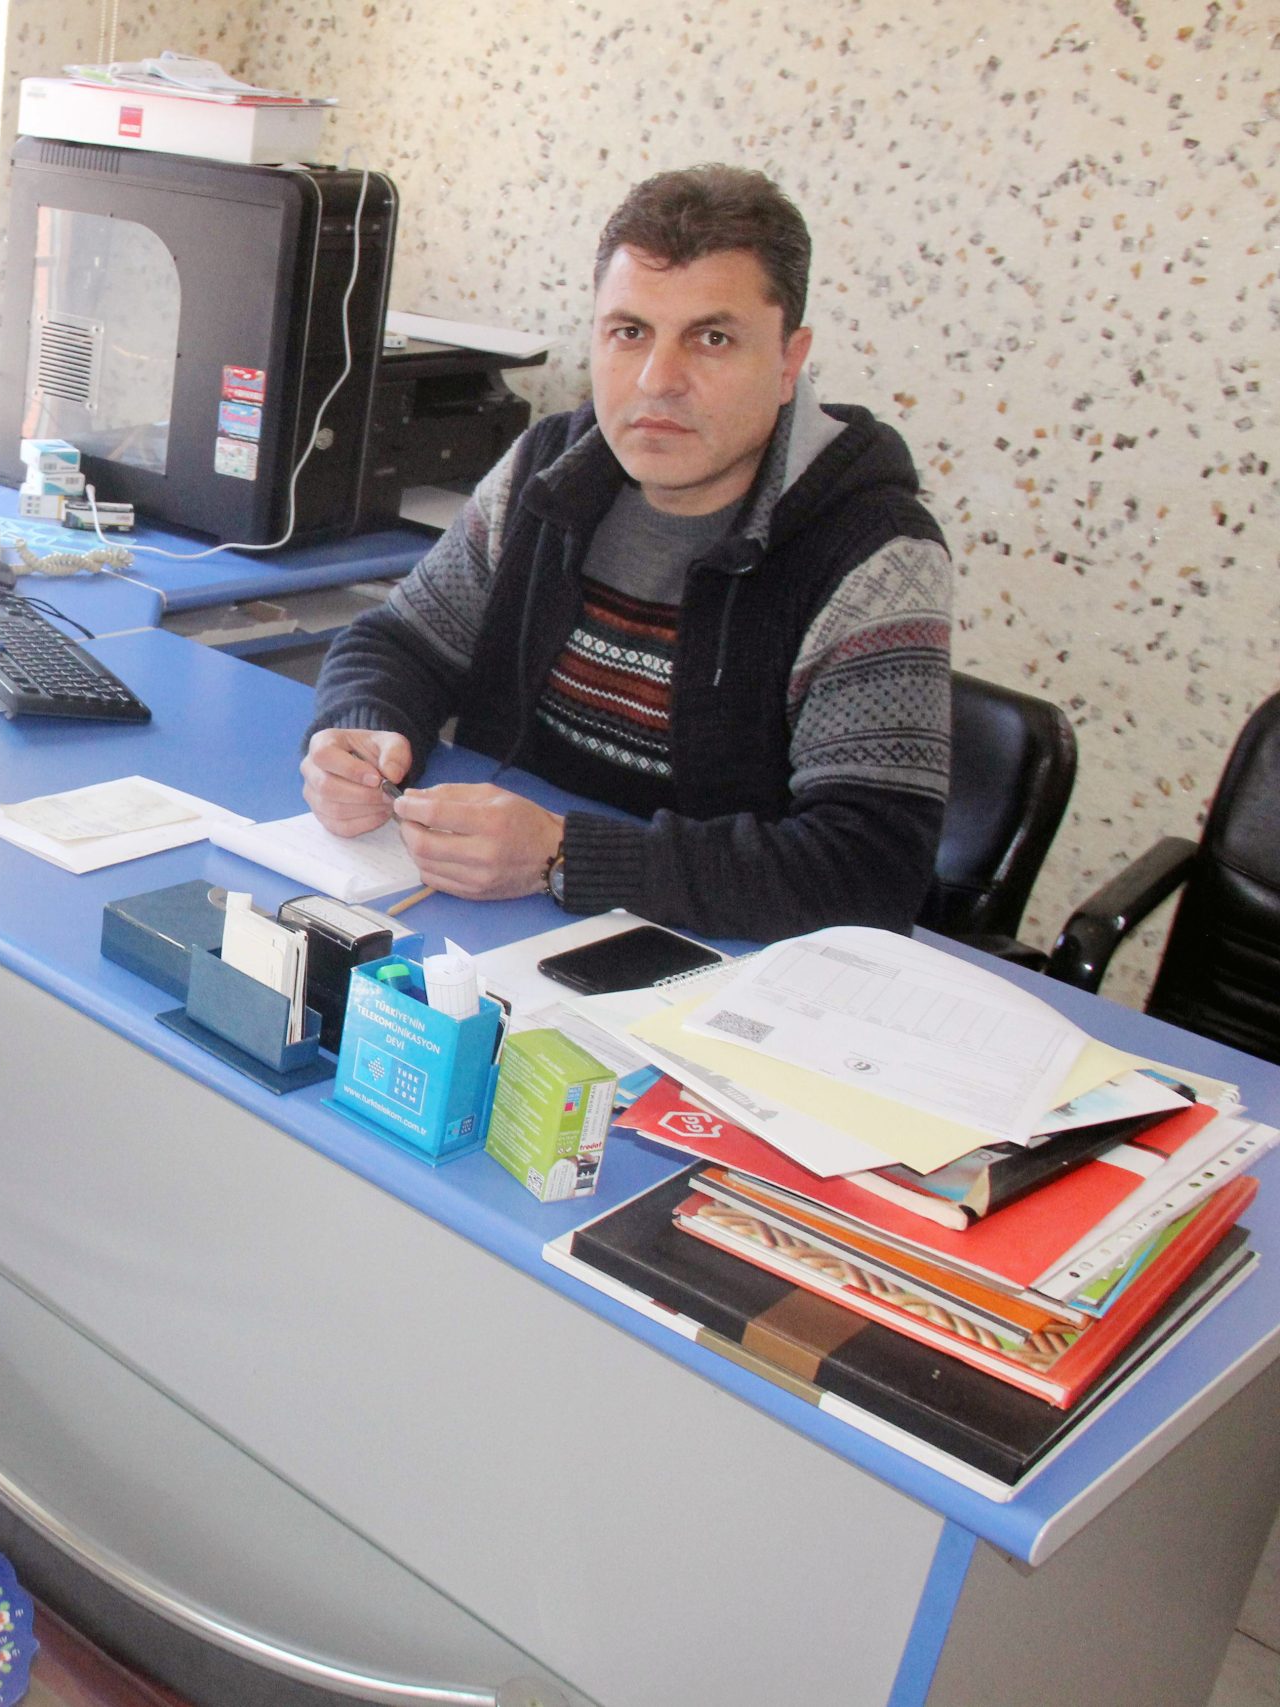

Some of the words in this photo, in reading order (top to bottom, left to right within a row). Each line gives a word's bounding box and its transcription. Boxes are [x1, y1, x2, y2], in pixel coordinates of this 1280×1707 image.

[357, 1004, 441, 1055] TELEKOMÜNİKASYON
[375, 999, 426, 1032] TÜRKİYE'NİN
[385, 1034, 405, 1051] DEVİ
[343, 1084, 427, 1136] www.turktelekom.com.tr
[580, 1142, 602, 1152] trodat
